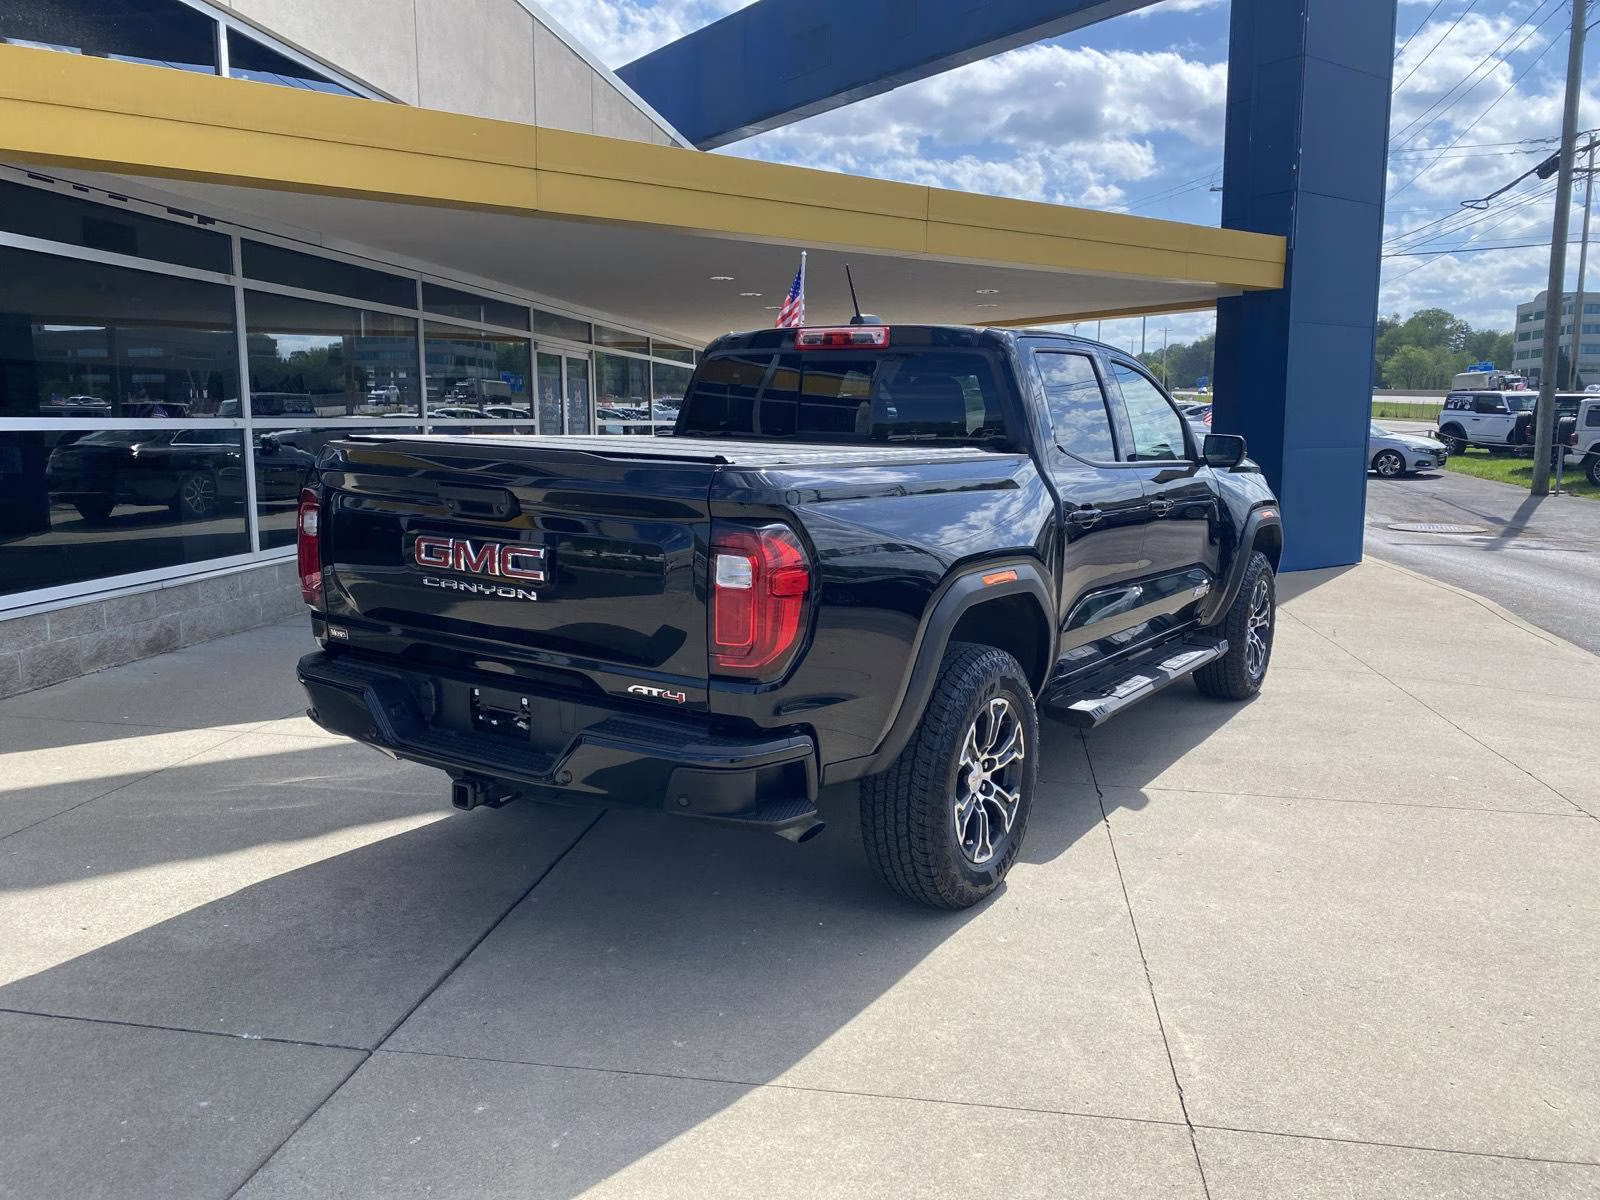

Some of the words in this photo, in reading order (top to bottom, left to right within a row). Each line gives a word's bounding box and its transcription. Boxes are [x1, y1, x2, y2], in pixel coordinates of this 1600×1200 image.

[415, 535, 545, 582] GMC
[422, 575, 538, 601] CANYON
[627, 684, 686, 704] AT4
